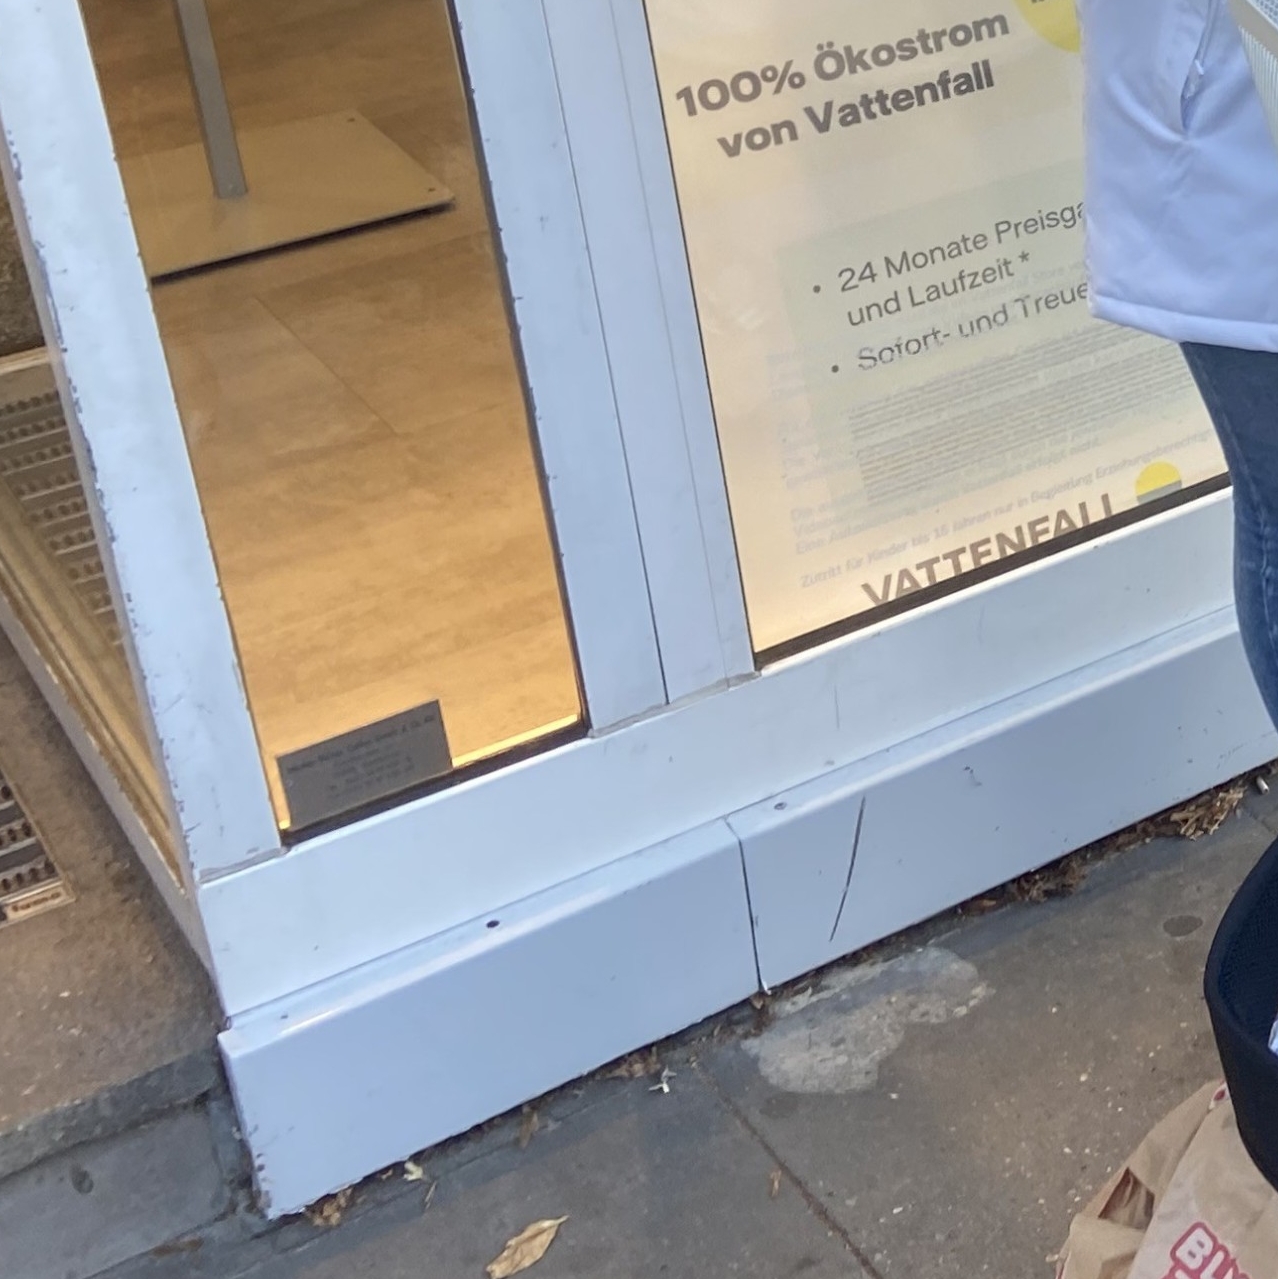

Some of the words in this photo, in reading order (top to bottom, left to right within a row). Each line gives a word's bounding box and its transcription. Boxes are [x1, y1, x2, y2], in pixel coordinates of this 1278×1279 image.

[676, 60, 807, 117] 100%
[813, 13, 1010, 82] Ökostrom
[717, 120, 799, 158] von
[804, 59, 995, 134] Vattenfall
[838, 262, 878, 292] 24
[884, 232, 988, 279] Monate
[848, 291, 902, 326] und
[858, 327, 950, 371] Sofort-
[958, 303, 1009, 338] und
[1014, 282, 1088, 319] Treue
